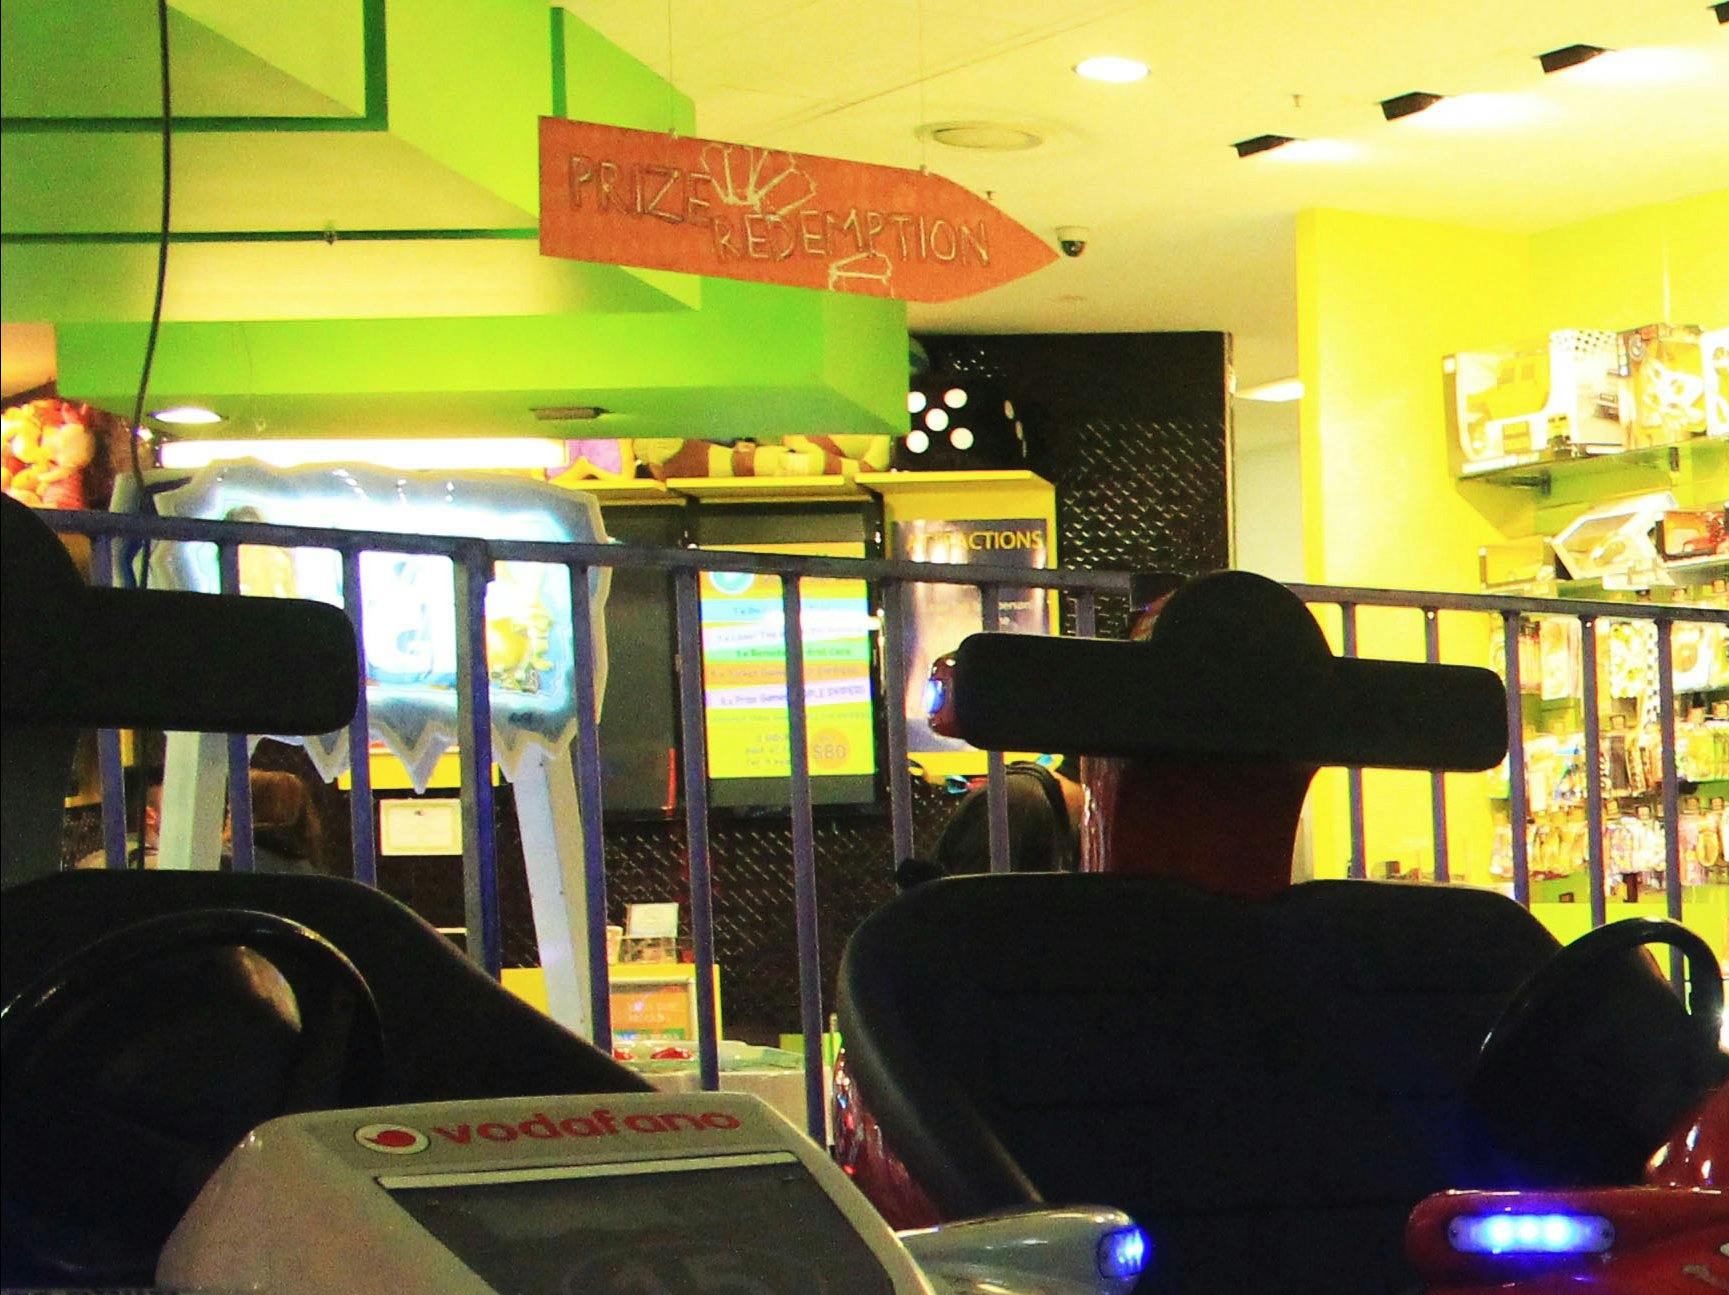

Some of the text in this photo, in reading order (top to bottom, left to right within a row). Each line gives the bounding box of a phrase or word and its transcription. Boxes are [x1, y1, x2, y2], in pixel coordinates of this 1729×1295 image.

[568, 155, 714, 229] PRIZE
[709, 207, 993, 266] REDEMPTION
[430, 1107, 742, 1146] vodafano
